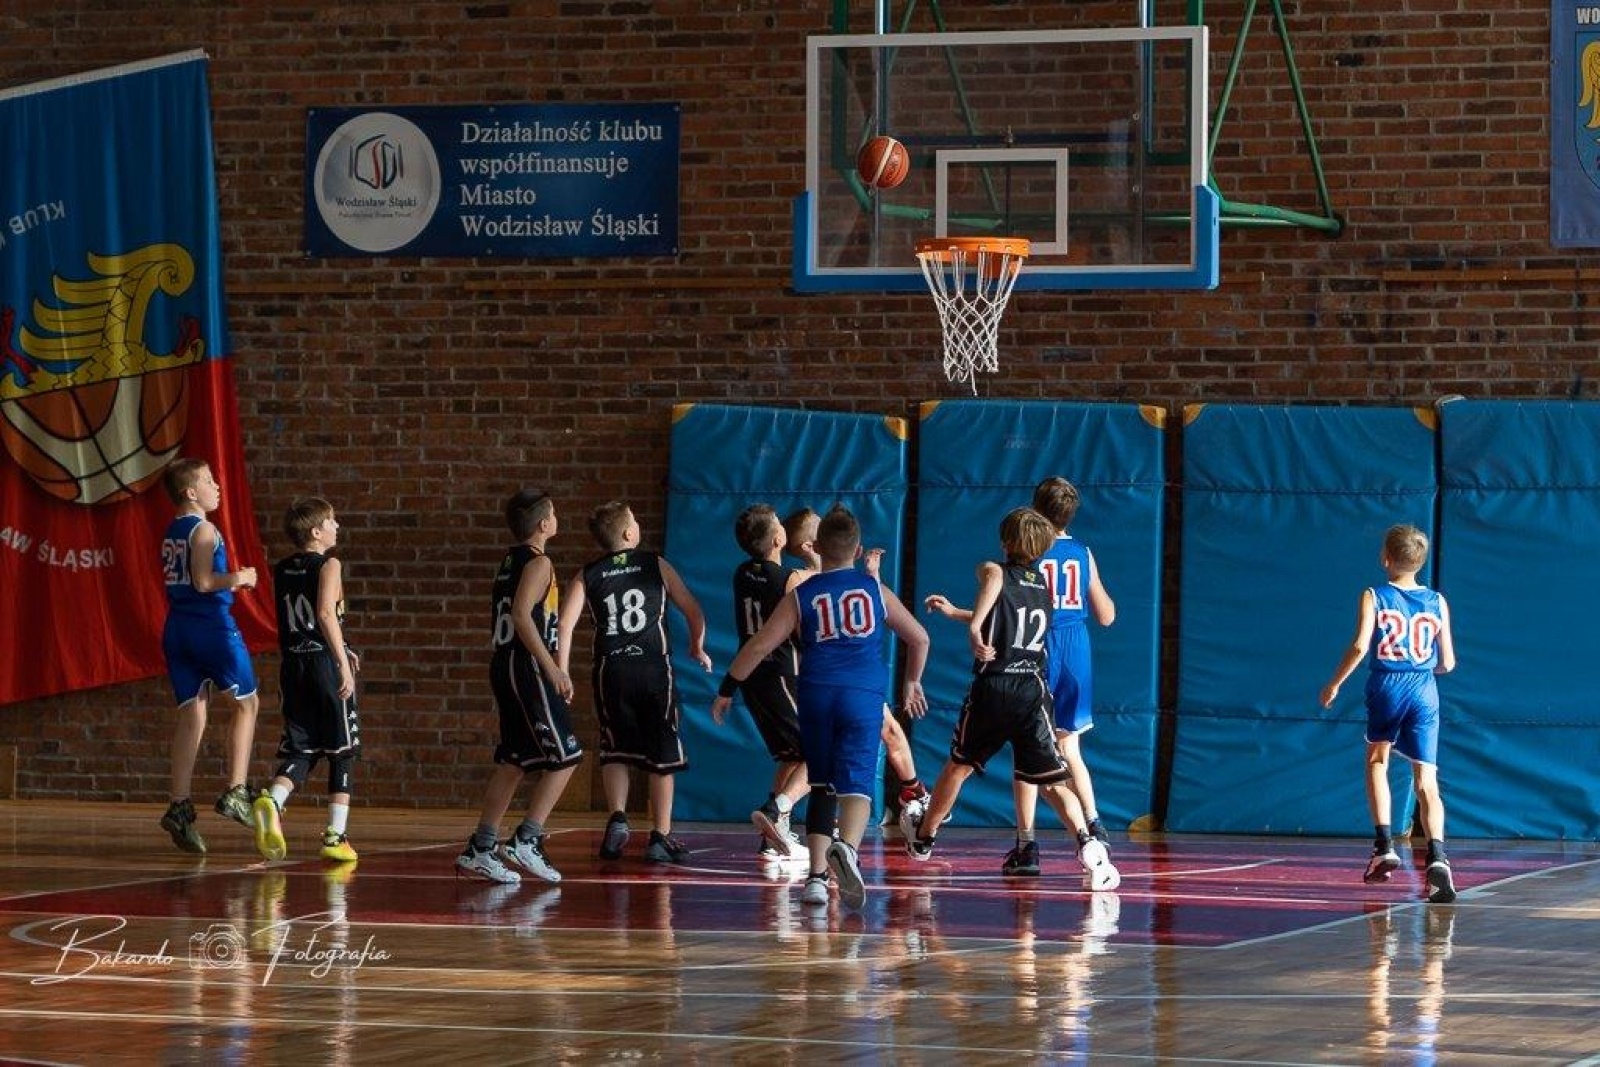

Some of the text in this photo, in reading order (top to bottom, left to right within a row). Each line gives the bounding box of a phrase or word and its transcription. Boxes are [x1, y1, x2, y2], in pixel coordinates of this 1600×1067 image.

[460, 120, 663, 143] Działalność klubu
[460, 151, 629, 179] współfinansuje
[335, 196, 387, 208] Wodzisław
[460, 184, 537, 206] Miasto
[8, 199, 66, 236] KLUB
[460, 207, 660, 241] Wodzisław Śląski
[38, 539, 114, 572] ŚLĄSKI
[162, 538, 192, 585] 21
[1039, 558, 1084, 610] 11
[283, 593, 316, 632] 10
[602, 588, 647, 636] 18
[811, 588, 876, 643] 10
[1011, 606, 1048, 652] 12
[1377, 608, 1442, 665] 20
